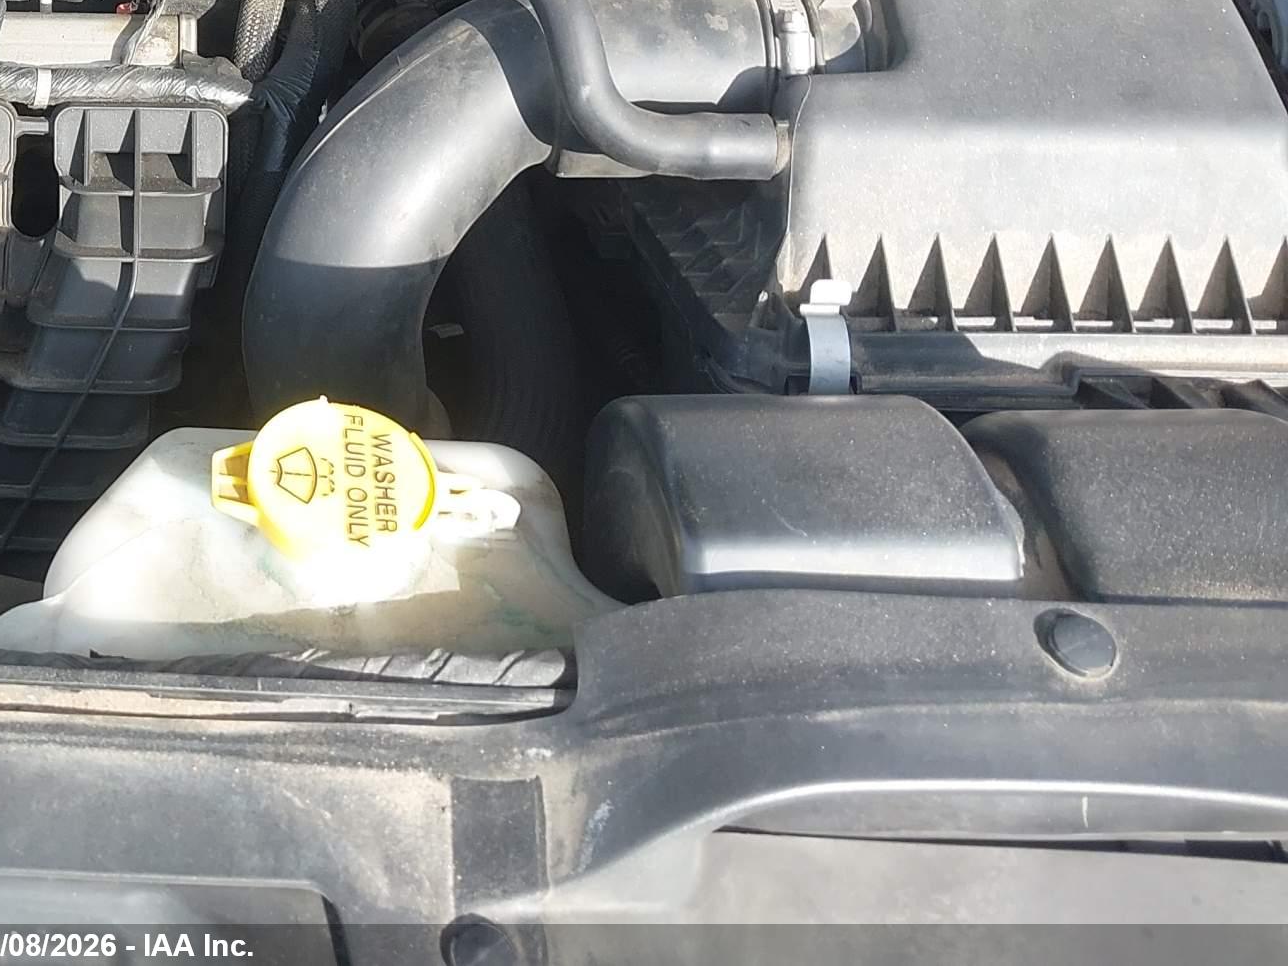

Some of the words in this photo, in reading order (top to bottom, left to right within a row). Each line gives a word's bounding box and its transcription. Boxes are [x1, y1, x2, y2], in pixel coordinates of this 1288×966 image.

[342, 413, 368, 480] FLUID
[369, 433, 398, 533] WASHER
[346, 486, 371, 548] ONLY
